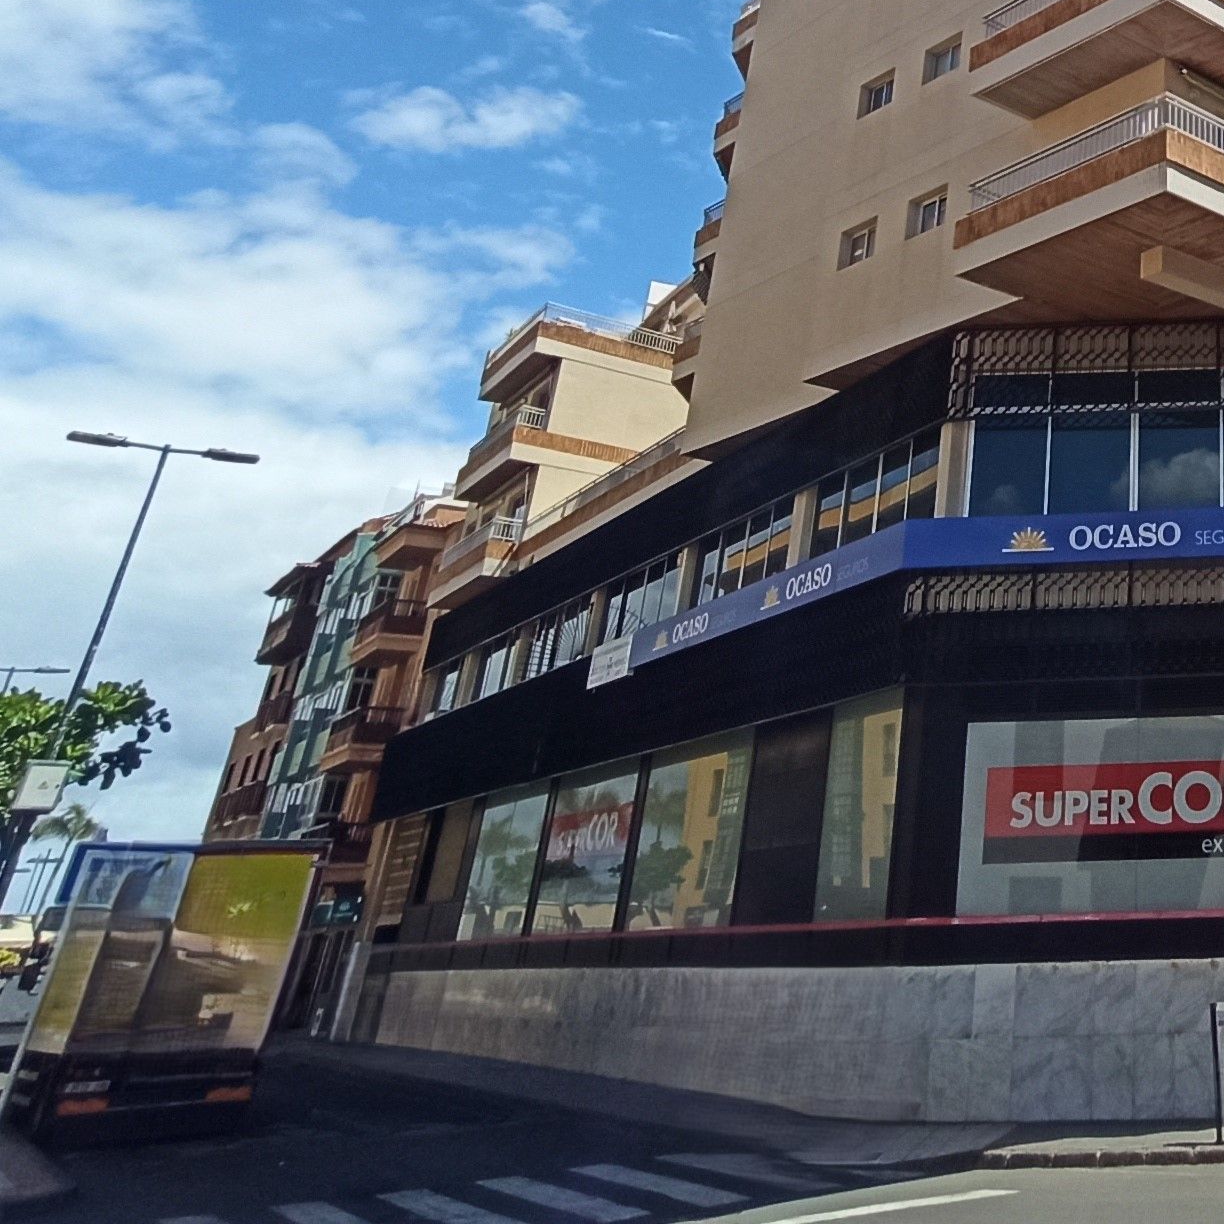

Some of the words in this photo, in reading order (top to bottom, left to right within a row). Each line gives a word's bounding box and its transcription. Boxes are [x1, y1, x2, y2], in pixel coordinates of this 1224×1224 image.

[1069, 521, 1181, 550] OCASO
[785, 562, 832, 600] OCASO
[672, 612, 709, 644] OCASO
